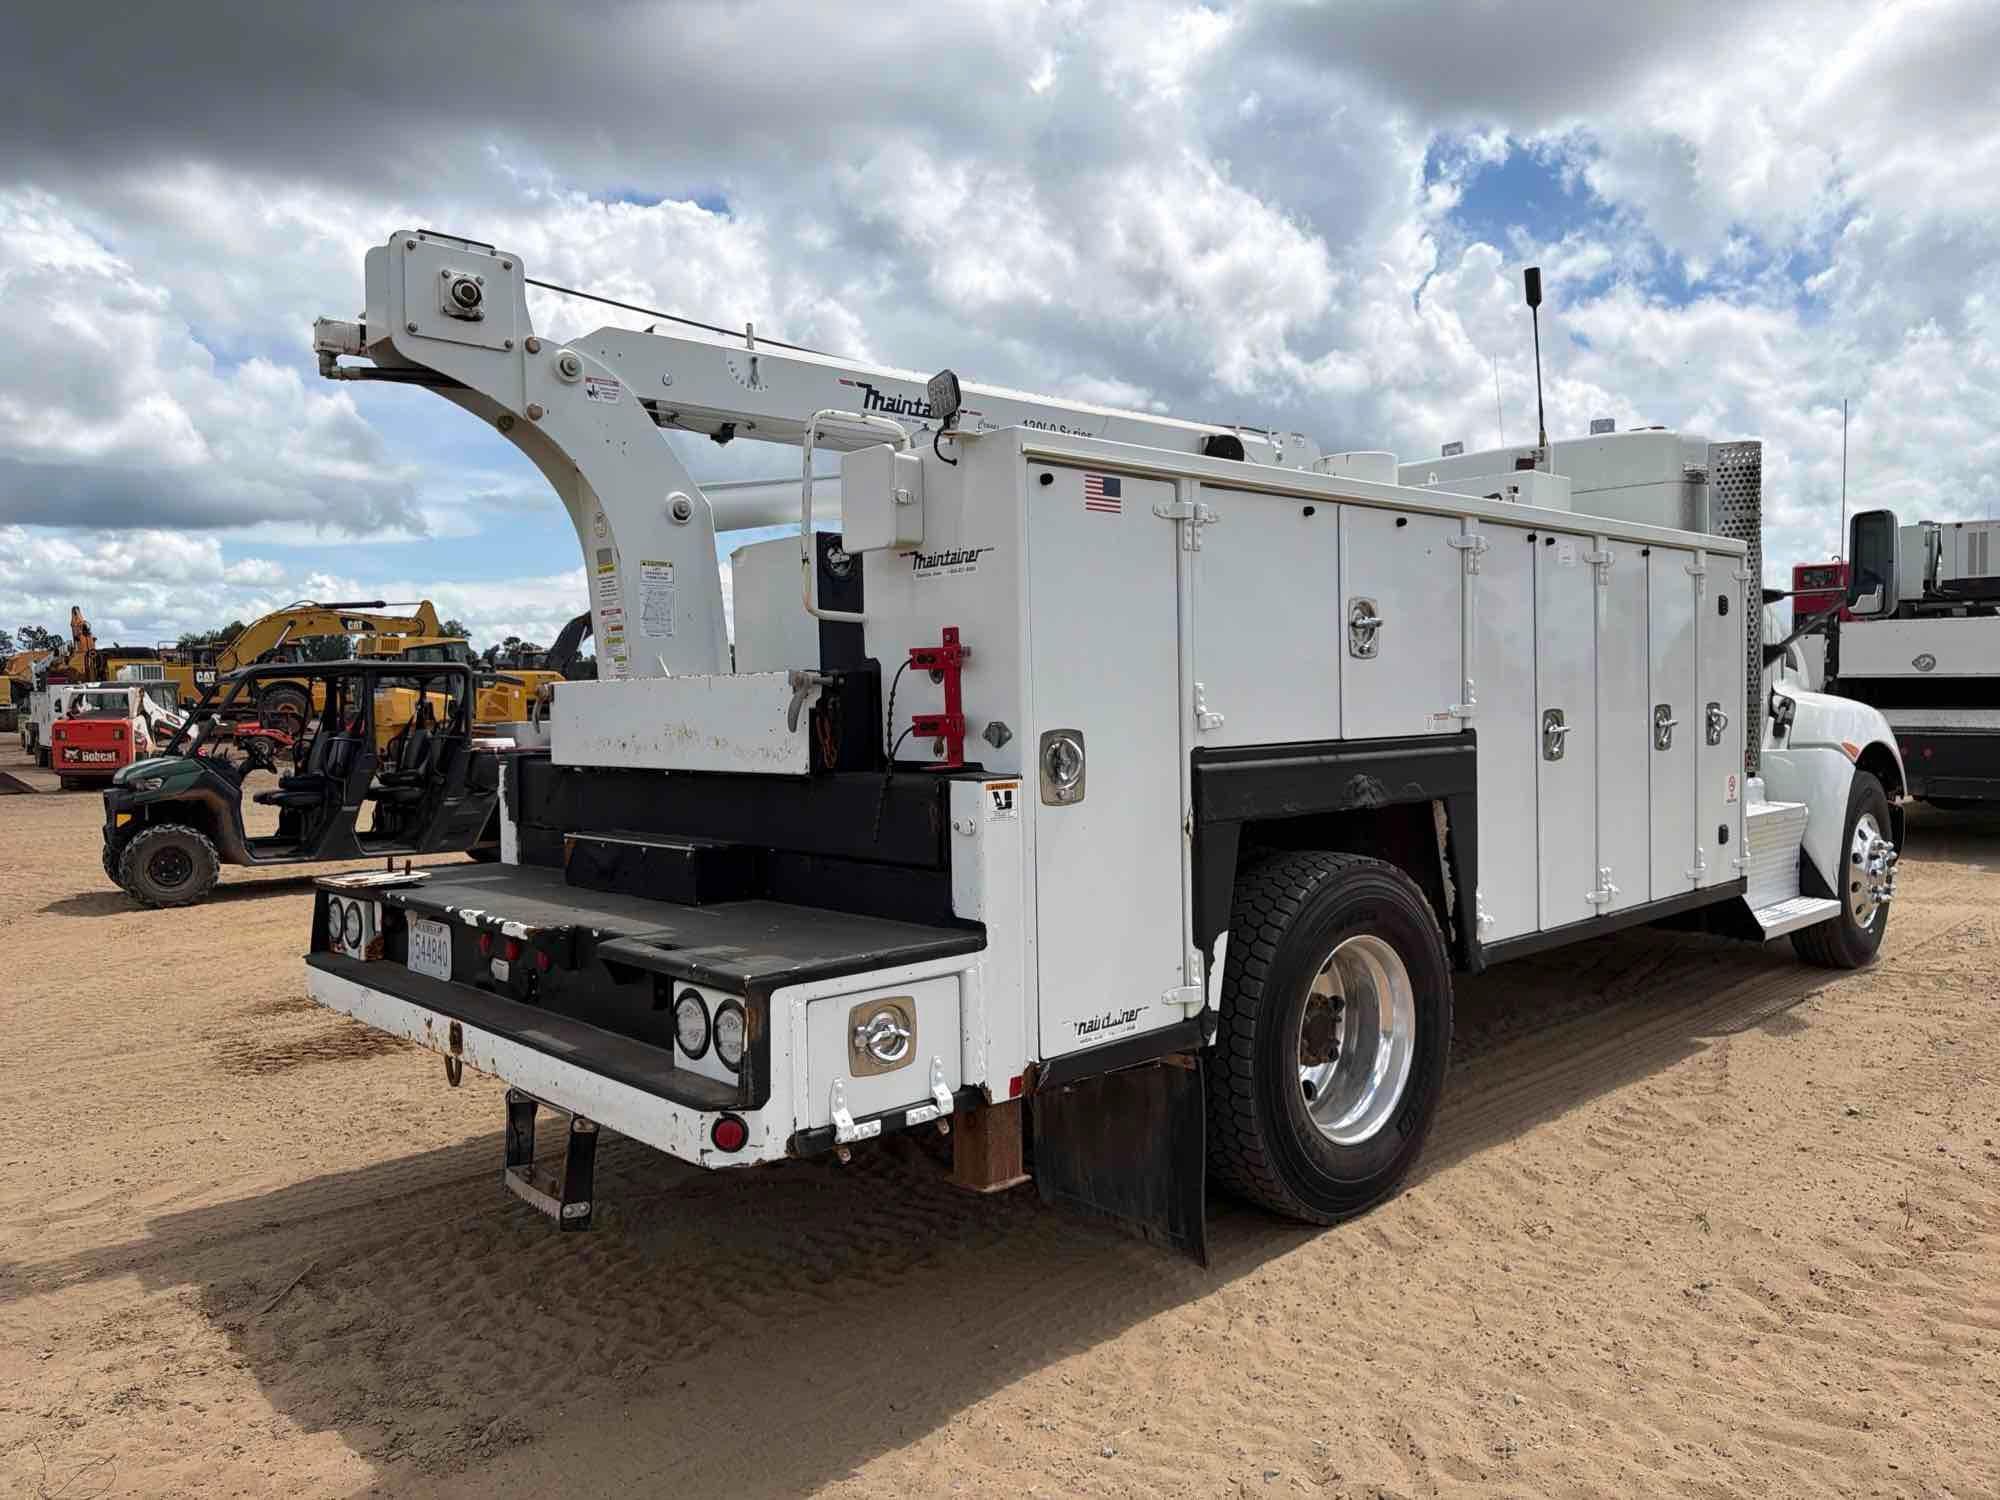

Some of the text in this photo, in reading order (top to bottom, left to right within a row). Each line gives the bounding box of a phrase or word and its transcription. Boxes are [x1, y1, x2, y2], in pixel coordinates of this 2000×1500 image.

[859, 381, 940, 420] Mainta
[910, 548, 984, 571] Maintainer
[347, 620, 363, 630] CAT
[195, 671, 216, 683] CAT
[81, 751, 116, 763] Bobcat
